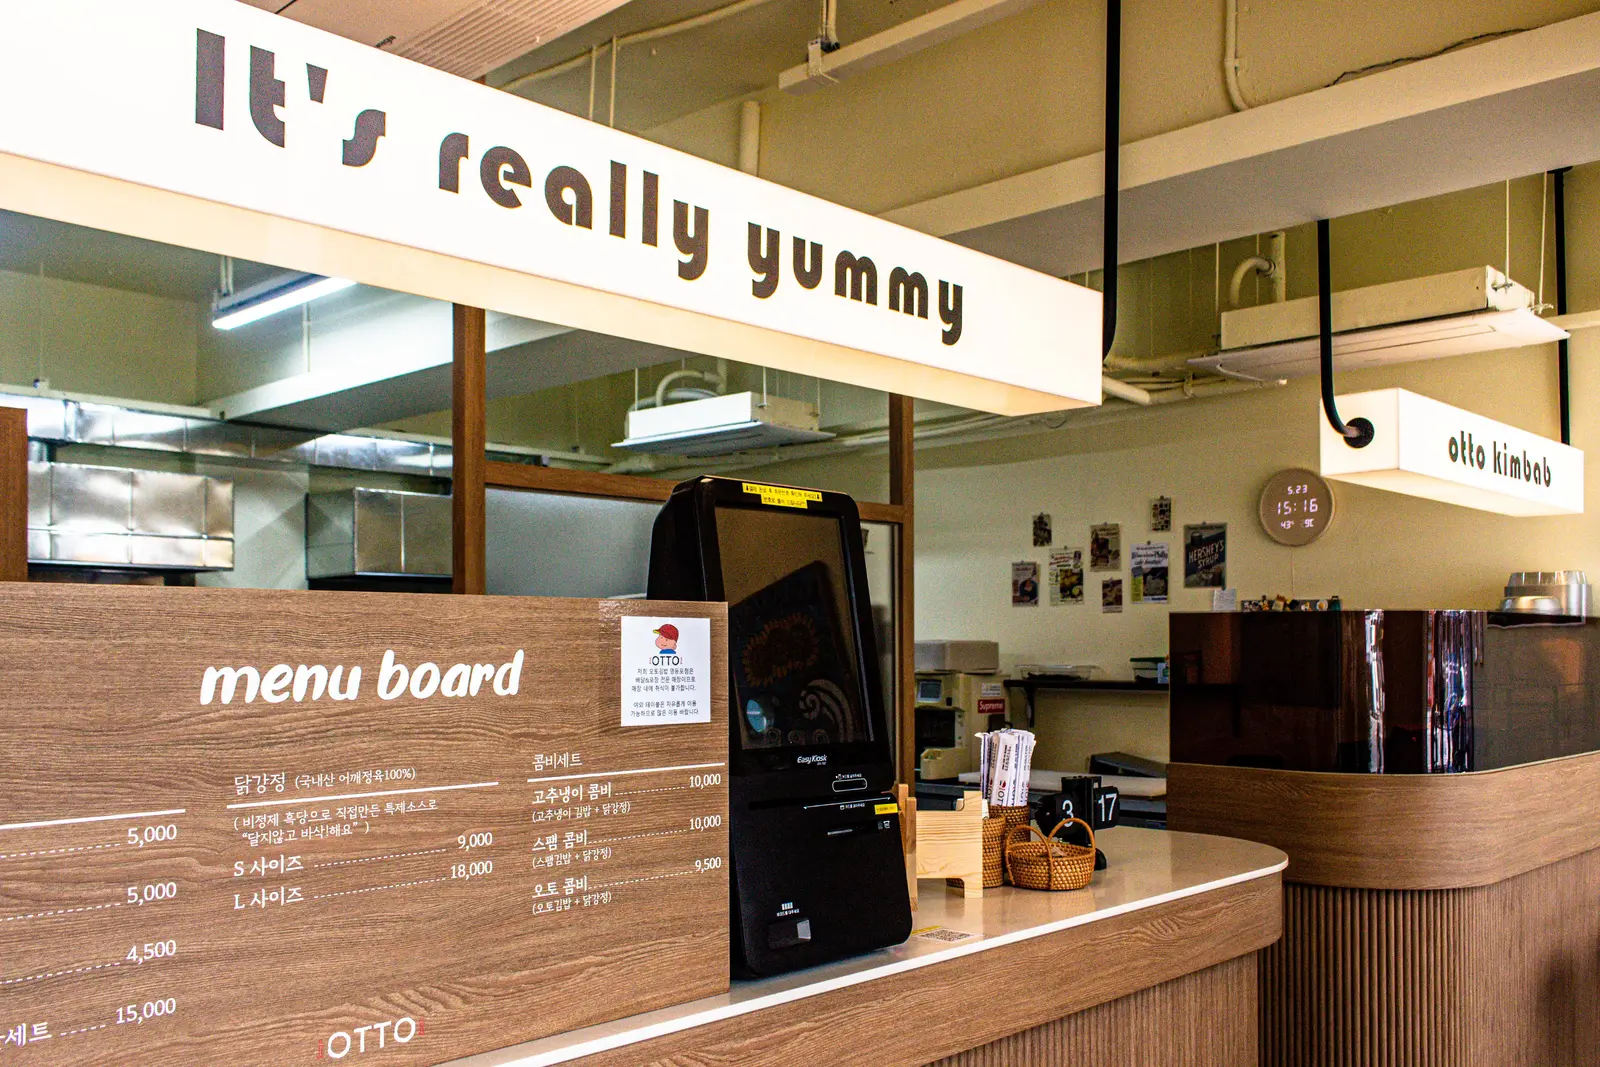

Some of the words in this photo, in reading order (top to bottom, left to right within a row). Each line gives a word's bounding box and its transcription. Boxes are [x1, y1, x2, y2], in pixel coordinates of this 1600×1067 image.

[195, 27, 387, 168] It's
[438, 132, 710, 282] really
[747, 221, 964, 346] yummy
[1448, 430, 1486, 470] otto
[1492, 440, 1552, 488] kimbab
[1287, 484, 1308, 495] 5.23
[1277, 498, 1318, 515] 15:16
[652, 655, 680, 666] OTTO
[200, 664, 362, 705] menu
[376, 649, 524, 701] board
[531, 752, 583, 772] 콤비세트
[234, 773, 286, 796] 닭강정
[295, 774, 334, 790] (국내산
[338, 767, 416, 786] 어깨정육100%)
[531, 784, 583, 804] 고추냉이
[587, 781, 612, 799] 콤비
[689, 773, 722, 790] 10,000
[283, 808, 333, 825] 흑당으로
[336, 804, 381, 821] 직접만든
[384, 799, 438, 814] 특제소스로
[532, 807, 571, 823] (고추냉이
[574, 805, 591, 817] 김밥
[602, 801, 631, 816] 닭강정)
[1062, 800, 1074, 828] 3
[1098, 793, 1117, 822] 17
[127, 824, 178, 847] 5,000
[531, 833, 558, 852] 스팸
[562, 829, 588, 849] 콤비
[689, 814, 722, 831] 10,000
[233, 860, 245, 877] S
[249, 854, 304, 877] 사이즈
[457, 831, 493, 852] 9,000
[532, 853, 572, 869] (스팸김밥
[582, 847, 612, 861] 닭강정)
[233, 894, 245, 910] L
[249, 886, 304, 909] 사이즈
[450, 860, 493, 881] 18,000
[531, 881, 560, 899] 오토
[562, 875, 588, 895] 콤비
[694, 856, 722, 873] 9,500
[127, 882, 178, 906] 5,000
[532, 899, 572, 916] (오토김밥
[582, 891, 612, 907] 닭강정)
[126, 939, 177, 964] 4,500
[0, 1022, 52, 1047] 세트
[115, 997, 177, 1026] 15,000
[328, 1017, 416, 1059] OTTO
